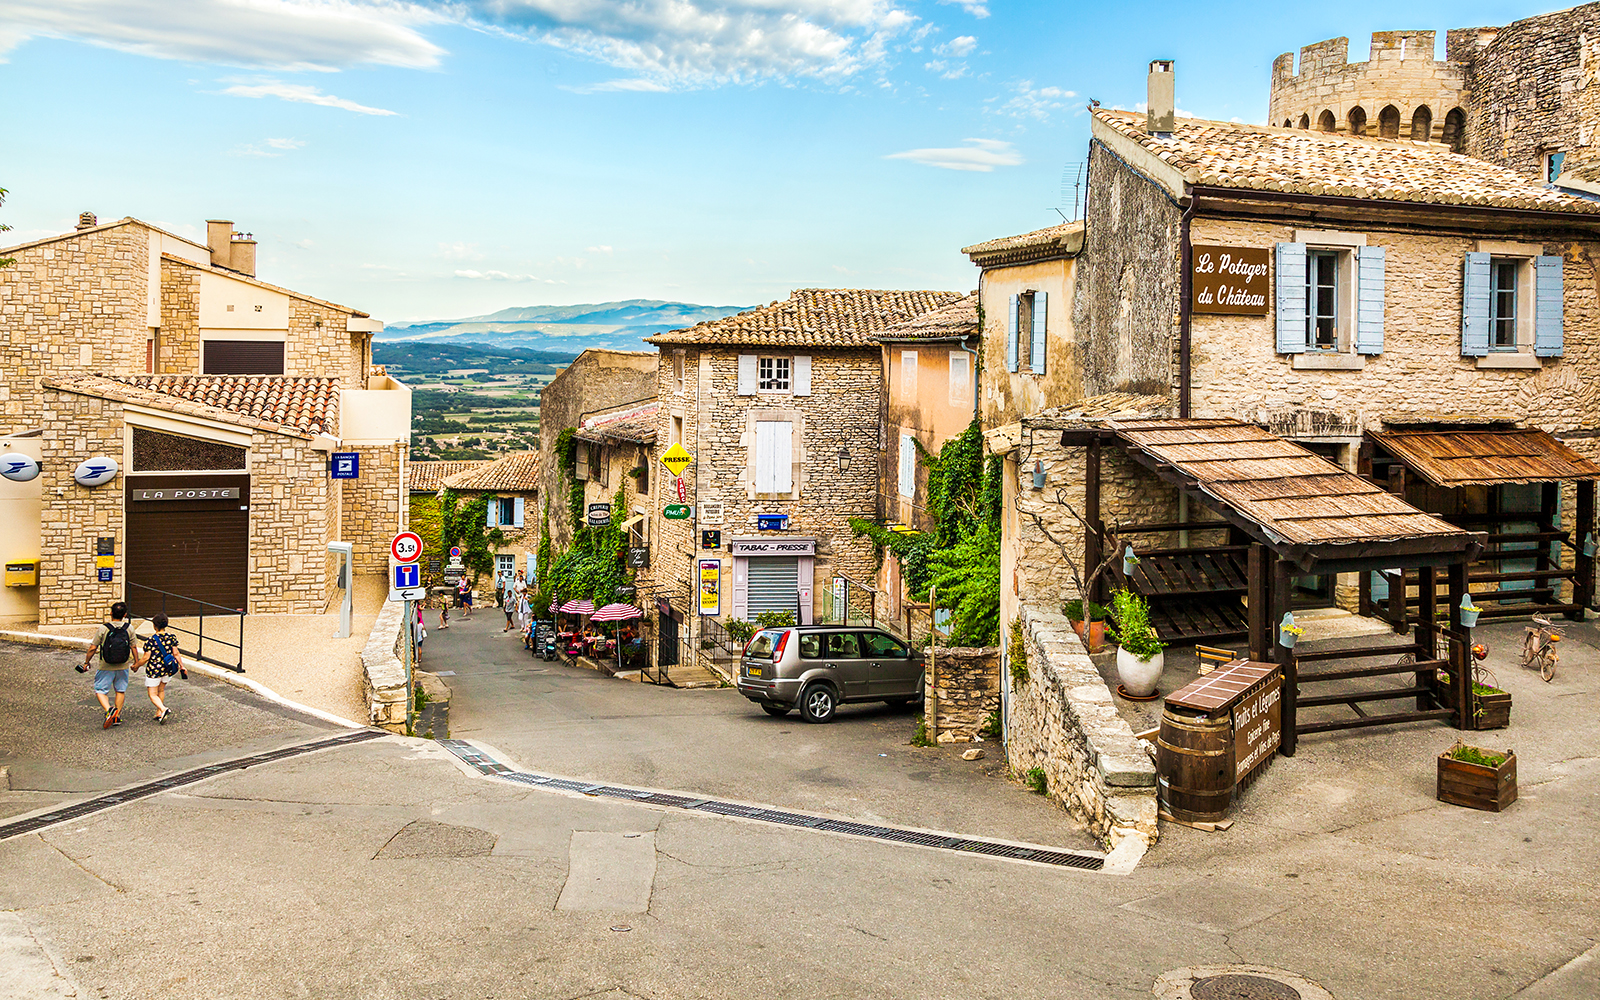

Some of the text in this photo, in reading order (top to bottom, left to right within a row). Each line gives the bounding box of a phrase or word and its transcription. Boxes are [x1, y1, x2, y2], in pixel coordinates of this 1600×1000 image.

[1195, 252, 1268, 284] Le Potager
[1198, 284, 1266, 306] du Château
[142, 490, 230, 499] LA POSTE
[678, 479, 686, 503] TABAC
[1235, 686, 1281, 731] Fruits et Légumes
[1262, 718, 1271, 733] fine
[1236, 751, 1254, 776] Fromages
[1253, 746, 1259, 760] et
[1258, 740, 1267, 755] Vins
[1267, 735, 1272, 749] de
